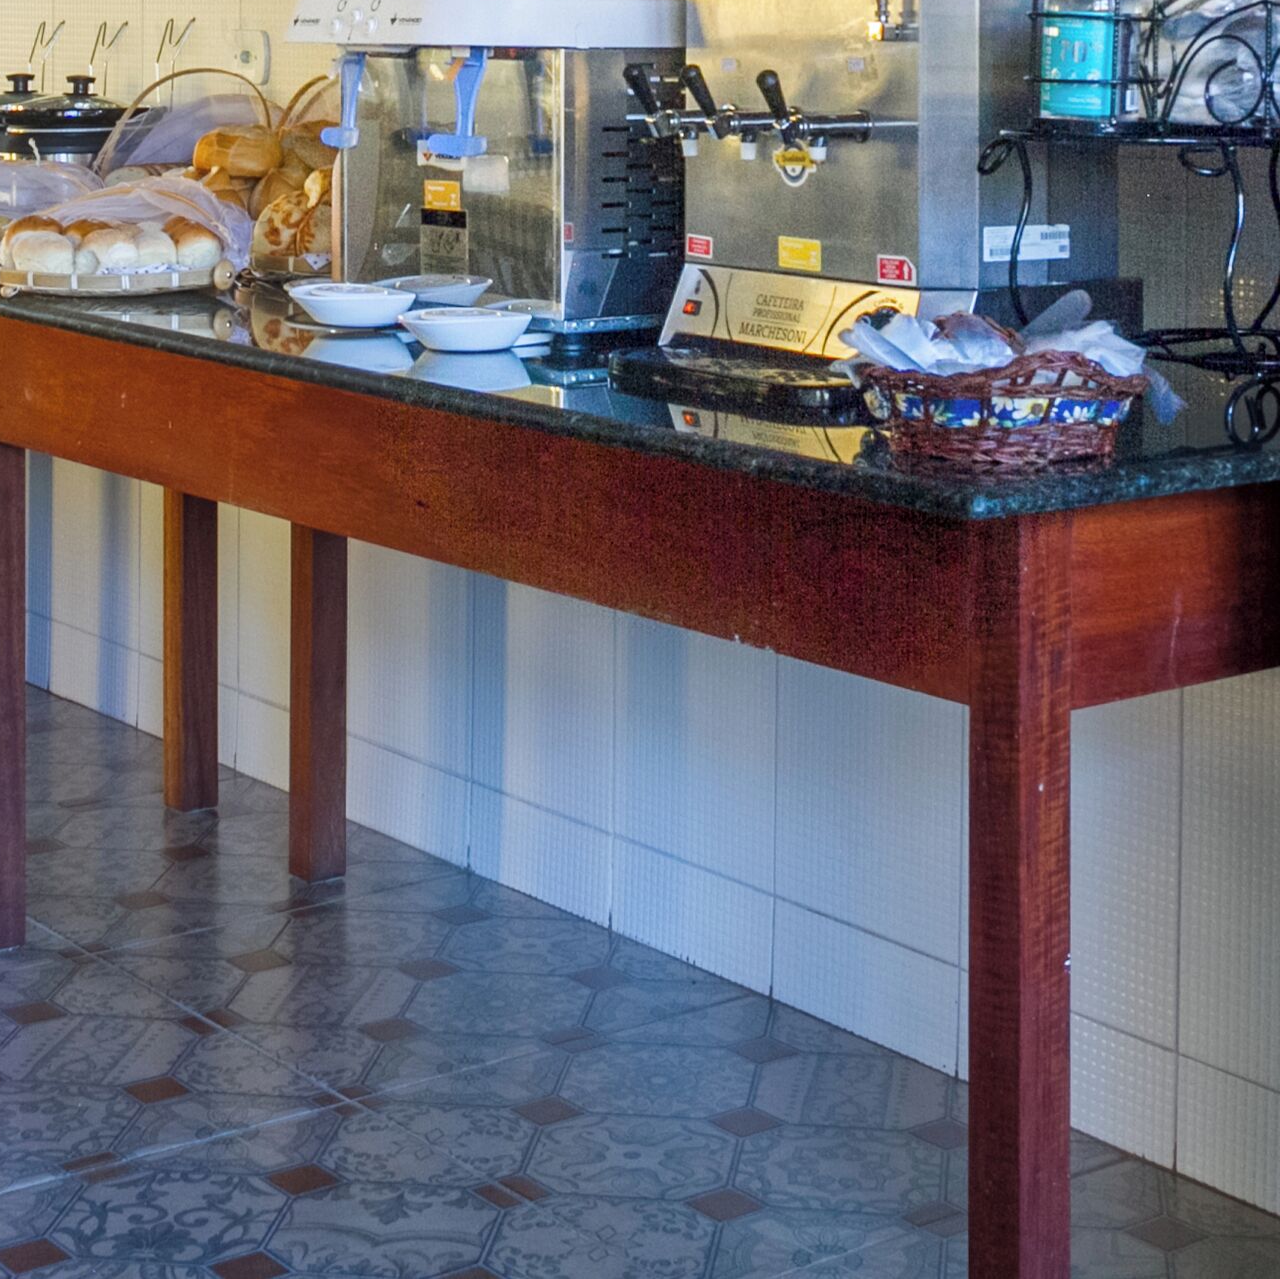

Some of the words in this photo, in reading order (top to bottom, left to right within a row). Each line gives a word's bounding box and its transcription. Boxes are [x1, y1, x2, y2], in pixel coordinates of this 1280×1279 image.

[756, 293, 805, 312] CAFETEIRA
[752, 308, 802, 323] PROFISSIONAL
[738, 321, 807, 345] MARCHESONI
